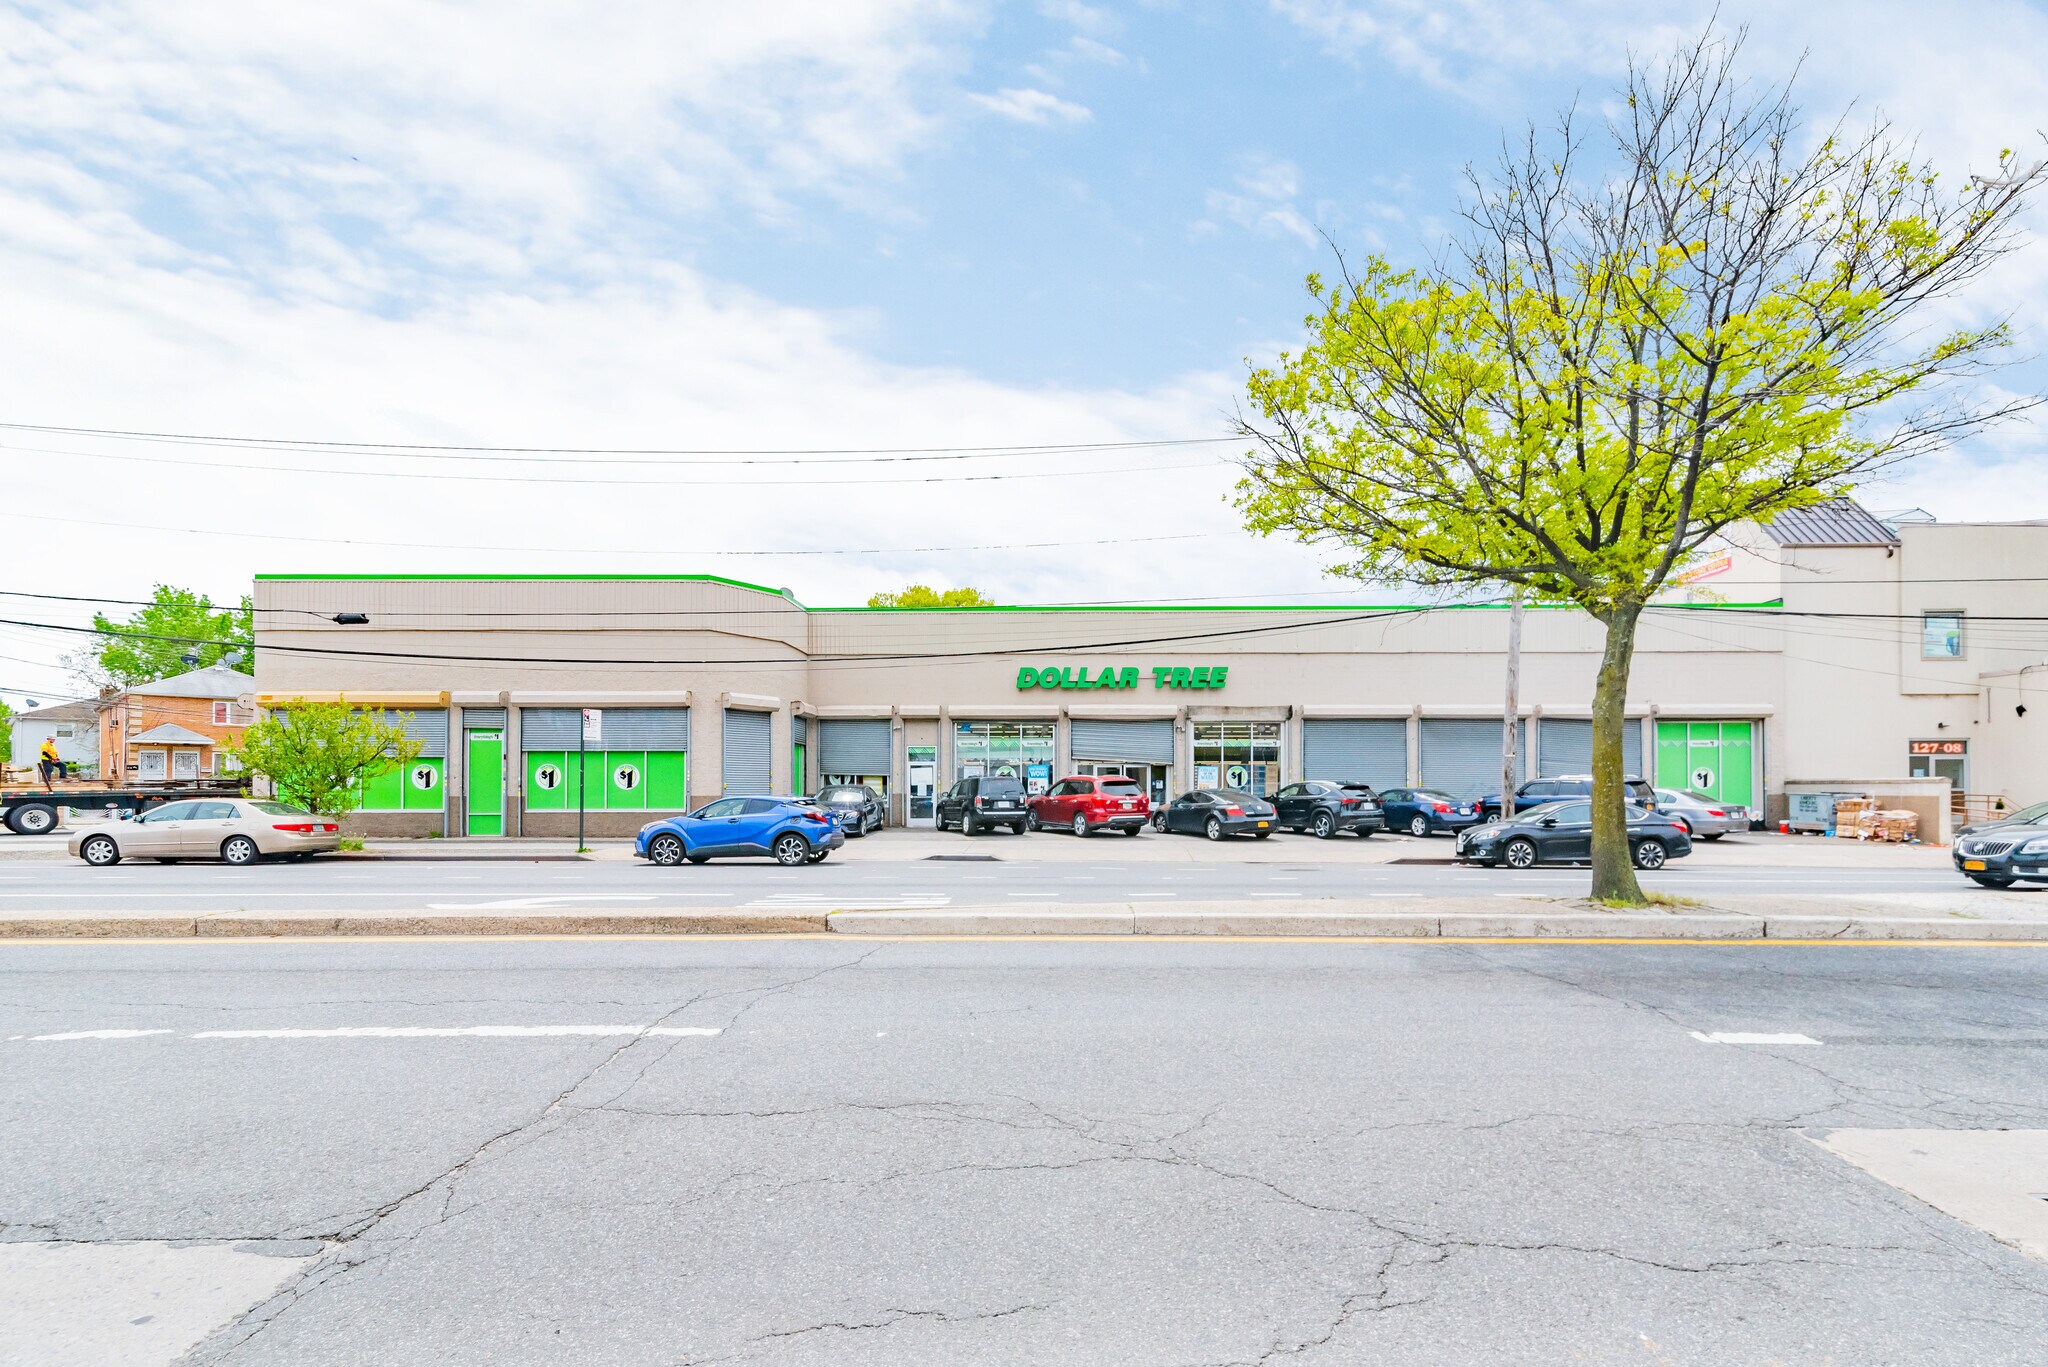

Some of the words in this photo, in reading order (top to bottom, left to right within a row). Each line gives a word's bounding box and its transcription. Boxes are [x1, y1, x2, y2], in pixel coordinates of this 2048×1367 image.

[1016, 666, 1139, 690] DOLLAR
[1151, 666, 1229, 690] TREE
[1911, 742, 1963, 754] 127-08
[417, 769, 431, 788] $1
[541, 769, 555, 788] $1
[619, 769, 634, 788] $1
[1231, 770, 1243, 786] $1
[1697, 772, 1708, 788] $1
